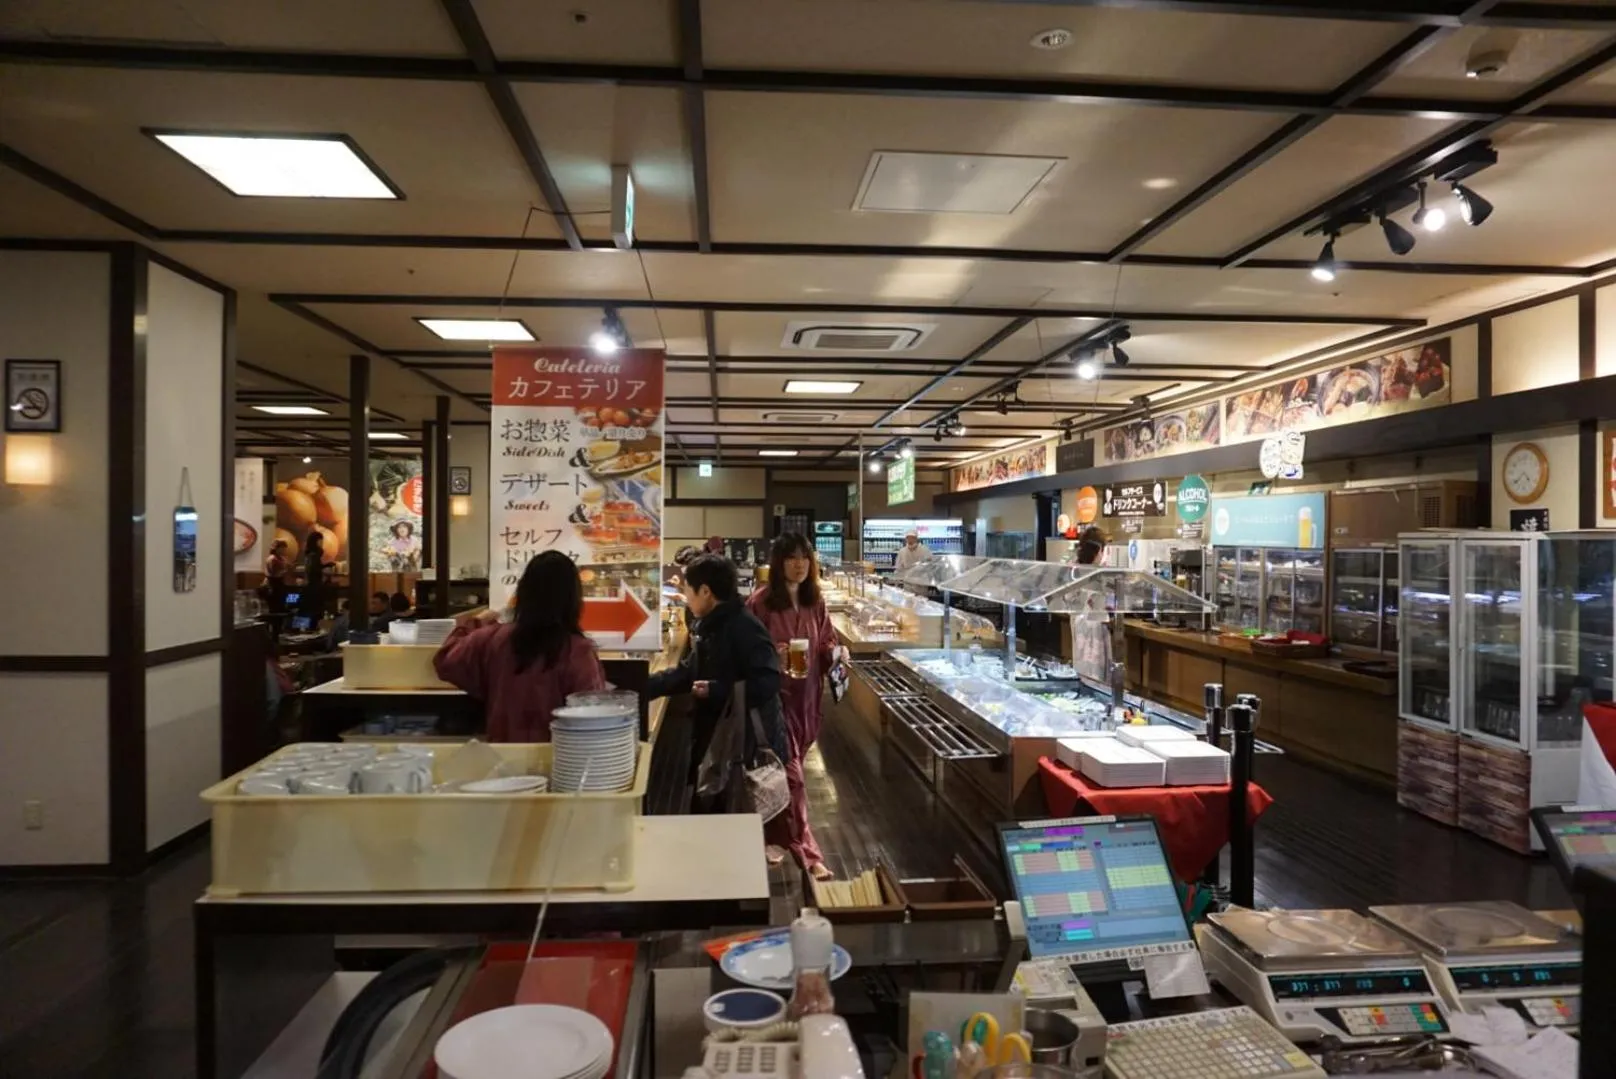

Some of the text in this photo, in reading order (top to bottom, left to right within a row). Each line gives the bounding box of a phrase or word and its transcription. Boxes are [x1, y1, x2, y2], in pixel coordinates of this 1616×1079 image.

[533, 357, 621, 374] Cafeteria
[507, 376, 647, 401] カフェテリア
[500, 418, 571, 443] お惣菜
[502, 446, 534, 458] Side
[568, 446, 591, 468] &
[500, 472, 588, 496] デザート
[1178, 486, 1208, 502] ALCOHOL
[504, 500, 550, 511] Sweets
[568, 504, 591, 524] &
[500, 526, 563, 546] セルフ
